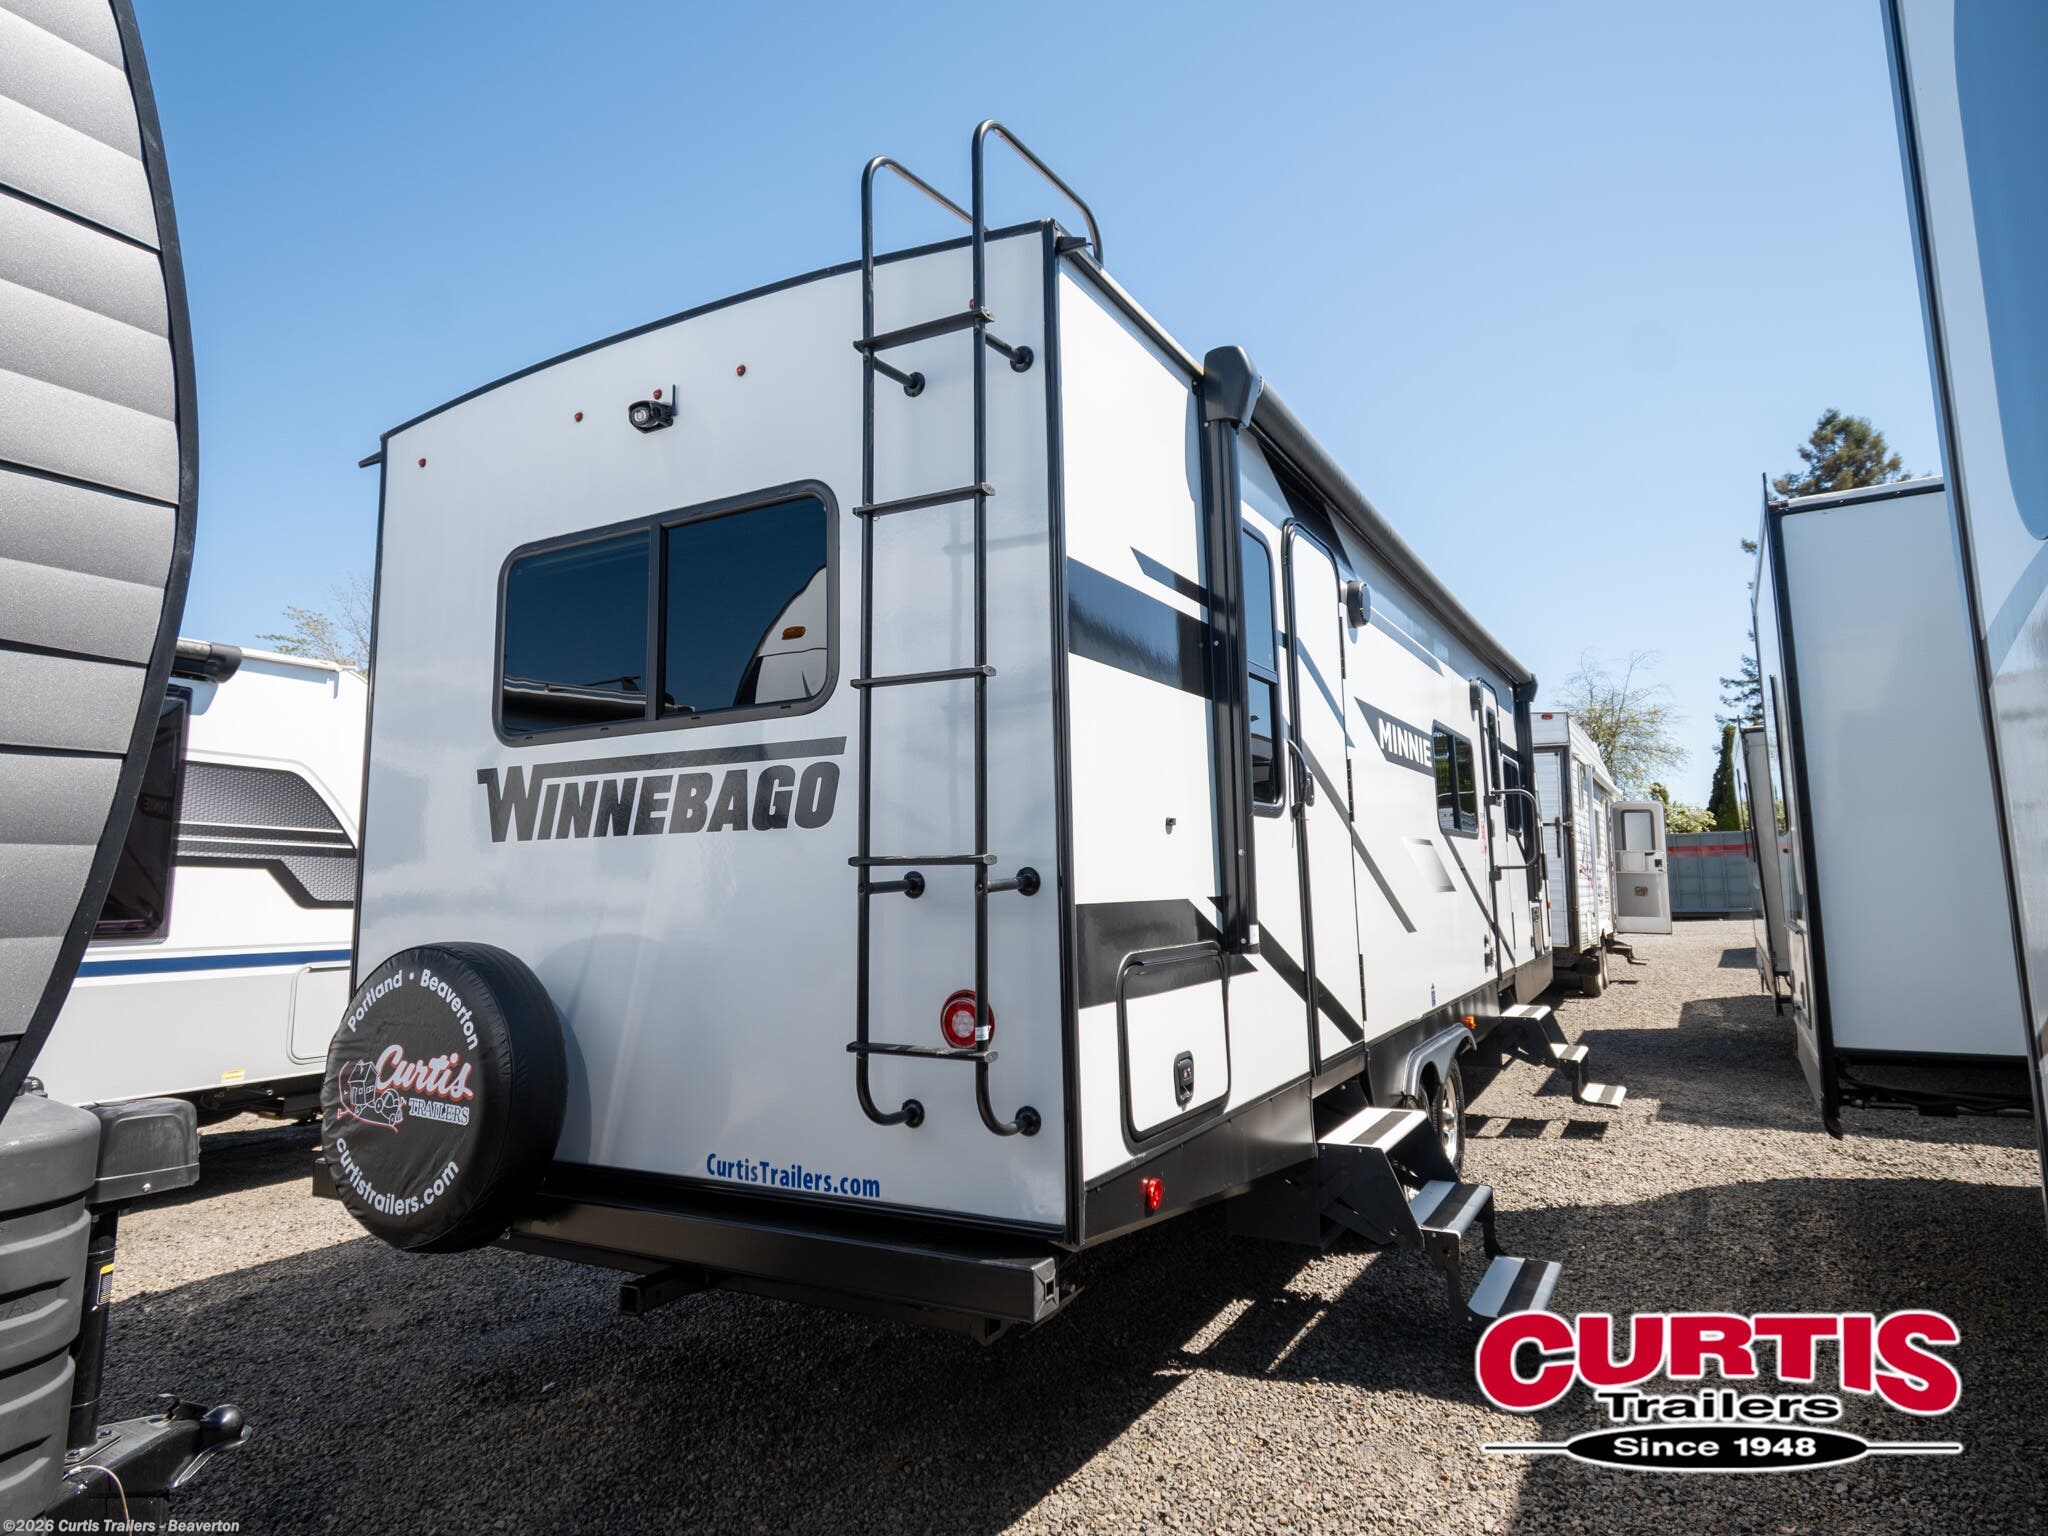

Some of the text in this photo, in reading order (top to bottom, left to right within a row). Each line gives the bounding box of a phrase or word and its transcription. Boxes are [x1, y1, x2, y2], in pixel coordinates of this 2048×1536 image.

[1378, 718, 1433, 768] MINNIE
[477, 736, 847, 843] WINNEBAGO
[347, 969, 403, 1033] Portland
[420, 968, 479, 1051] Beaverton
[375, 1044, 474, 1101] Curtis
[408, 1097, 470, 1126] TRAILERS
[336, 1137, 460, 1216] curtistrailers.com
[706, 1153, 880, 1198] CurtisTrailers.com
